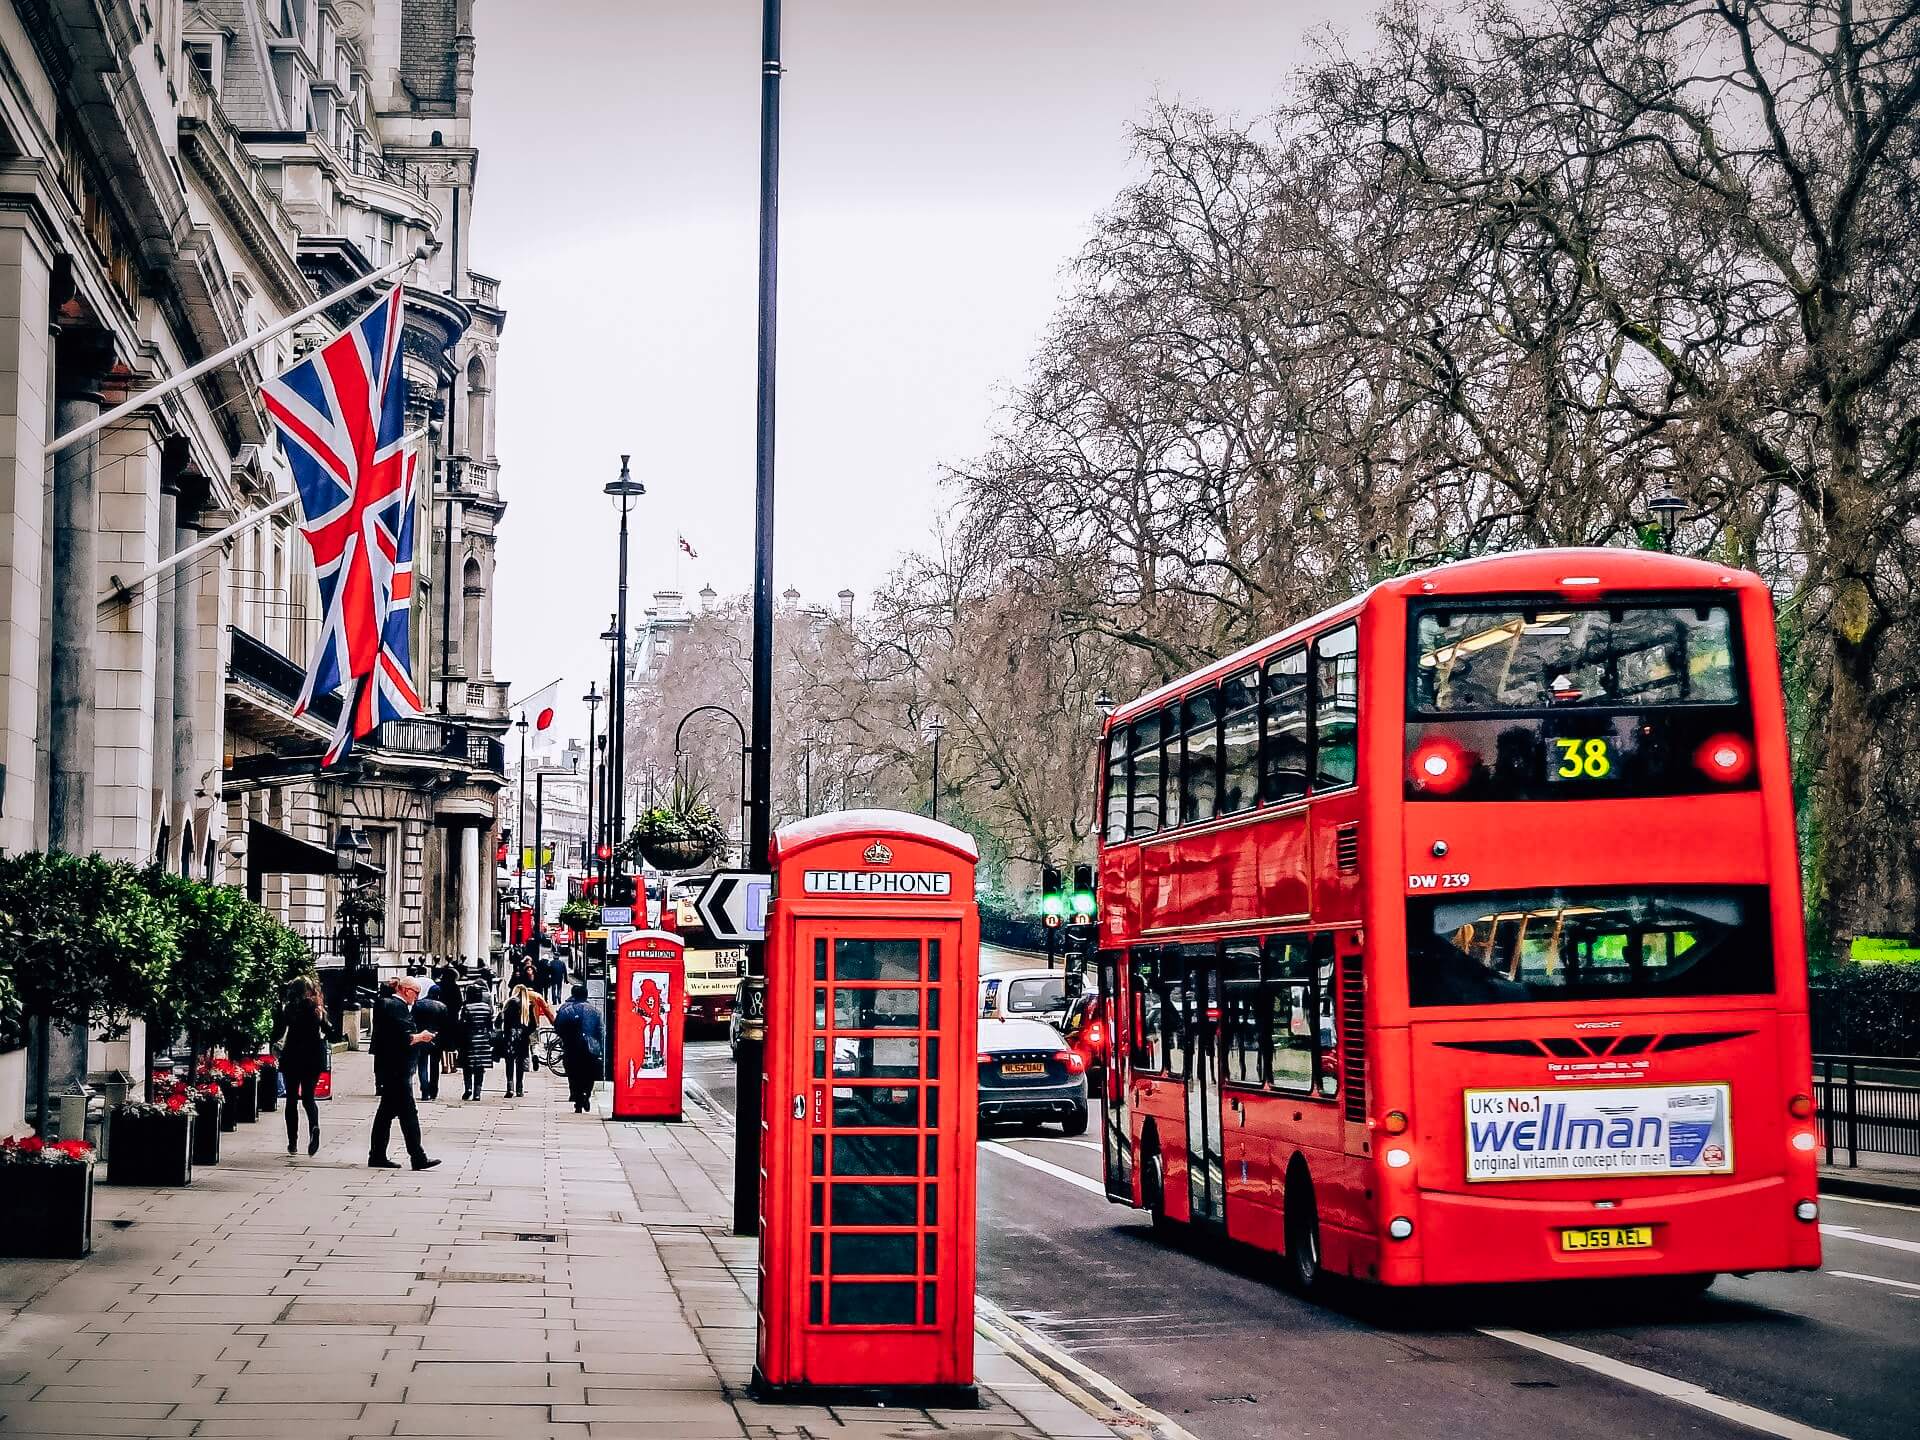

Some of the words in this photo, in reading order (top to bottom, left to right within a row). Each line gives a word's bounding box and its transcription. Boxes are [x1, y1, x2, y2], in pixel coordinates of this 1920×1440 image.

[1556, 738, 1610, 778] 38
[808, 872, 945, 893] TELEPHONE
[1408, 875, 1437, 889] DW
[1442, 873, 1470, 887] 239
[629, 950, 675, 958] TELEPHONE
[1471, 1097, 1504, 1114] UK's
[1508, 1095, 1541, 1113] No.1
[1470, 1103, 1662, 1153] wellman
[1474, 1154, 1520, 1174] original
[1523, 1153, 1568, 1169] vitamin
[1572, 1154, 1617, 1170] concept
[1620, 1150, 1637, 1166] for
[1639, 1153, 1666, 1166] men
[1568, 1231, 1610, 1248] LJ59
[1616, 1229, 1647, 1246] AEL
